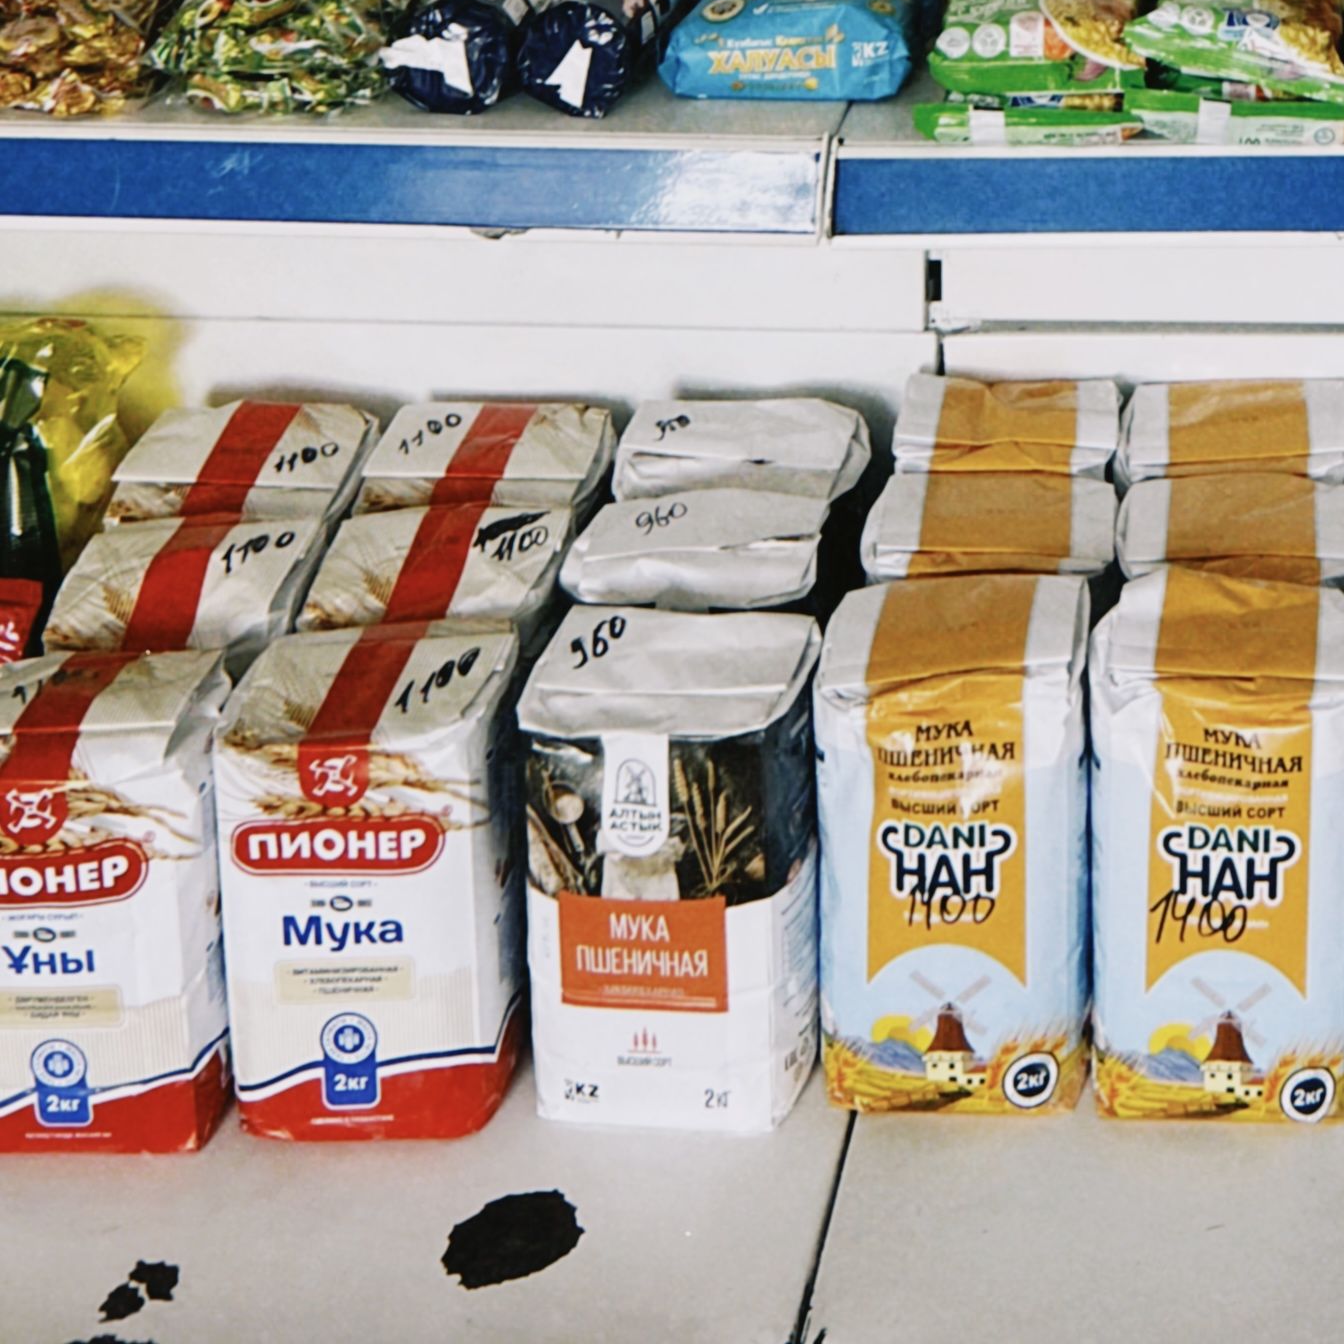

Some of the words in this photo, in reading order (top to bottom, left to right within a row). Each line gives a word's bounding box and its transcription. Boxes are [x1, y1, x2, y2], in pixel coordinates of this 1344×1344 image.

[707, 44, 836, 75] ХАЛУАСЫ
[864, 41, 888, 58] KZ
[635, 502, 686, 533] 960
[395, 646, 482, 709] 1100
[916, 720, 973, 742] МУКА
[1203, 728, 1262, 750] МУКА
[877, 742, 1015, 768] ПШЕНИЧНАЯ
[1165, 743, 1303, 775] ПШЕНИЧНАЯ
[609, 808, 662, 821] АЛТЫН
[891, 798, 956, 815] ВЫСШИЙ
[1176, 800, 1242, 818] ВЫСШИЙ
[1247, 806, 1286, 819] СОРТ
[248, 827, 427, 863] ПИОНЕР
[904, 823, 986, 849] DANI
[1188, 826, 1271, 853] DANI
[609, 913, 670, 943] МУКА
[1149, 888, 1248, 944] 1400
[282, 915, 404, 952] Мука
[2, 945, 95, 976] Ұны
[576, 944, 709, 977] ПШЕНИЧНАЯ
[334, 1074, 369, 1092] 2кг
[575, 1083, 600, 1098] KZ
[1016, 1065, 1048, 1090] 2кг
[46, 1094, 81, 1113] 2кг
[1293, 1083, 1324, 1108] 2кг
